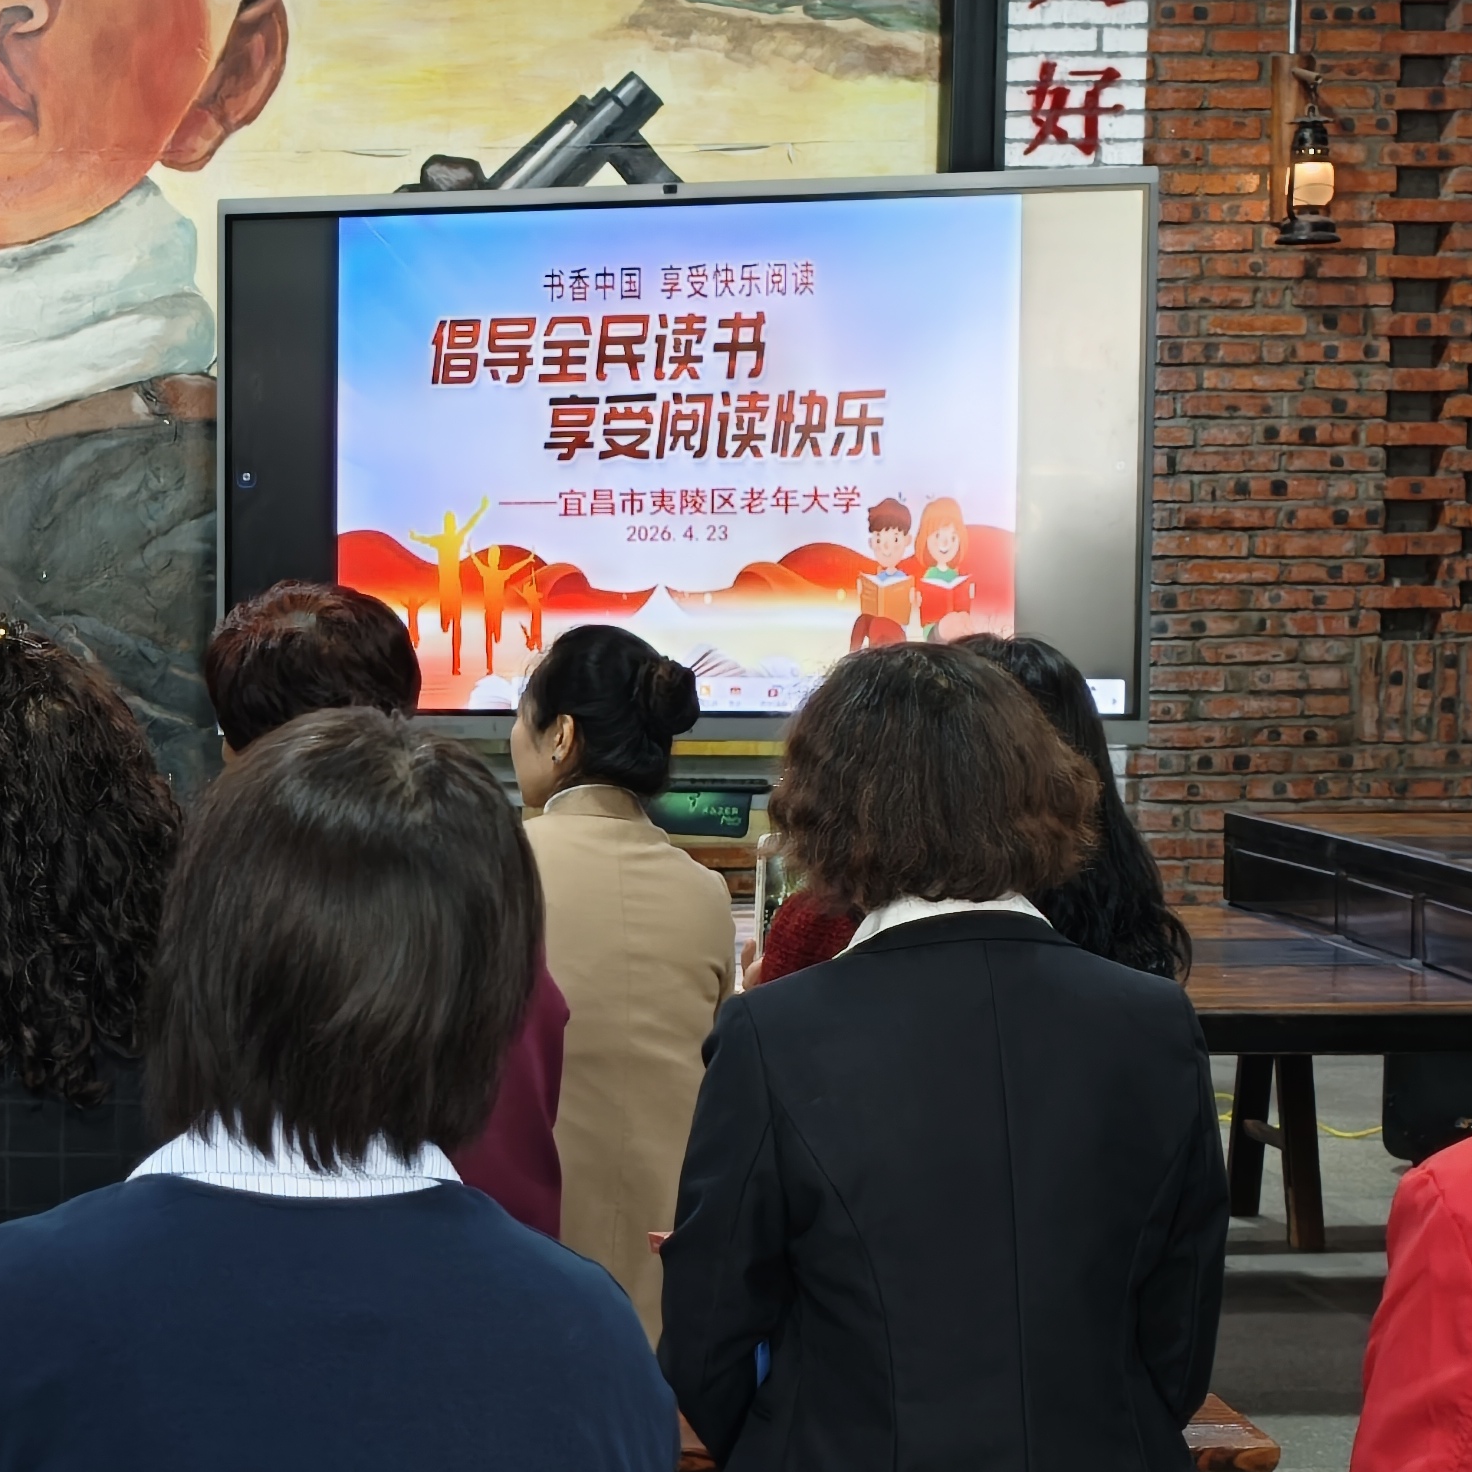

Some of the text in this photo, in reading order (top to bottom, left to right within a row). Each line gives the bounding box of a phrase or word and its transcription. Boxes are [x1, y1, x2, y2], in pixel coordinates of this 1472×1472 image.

[543, 260, 816, 303] 书香中国 享受快乐阅读
[429, 310, 767, 386] 倡导全民读书
[543, 388, 887, 462] 享受阅读快乐
